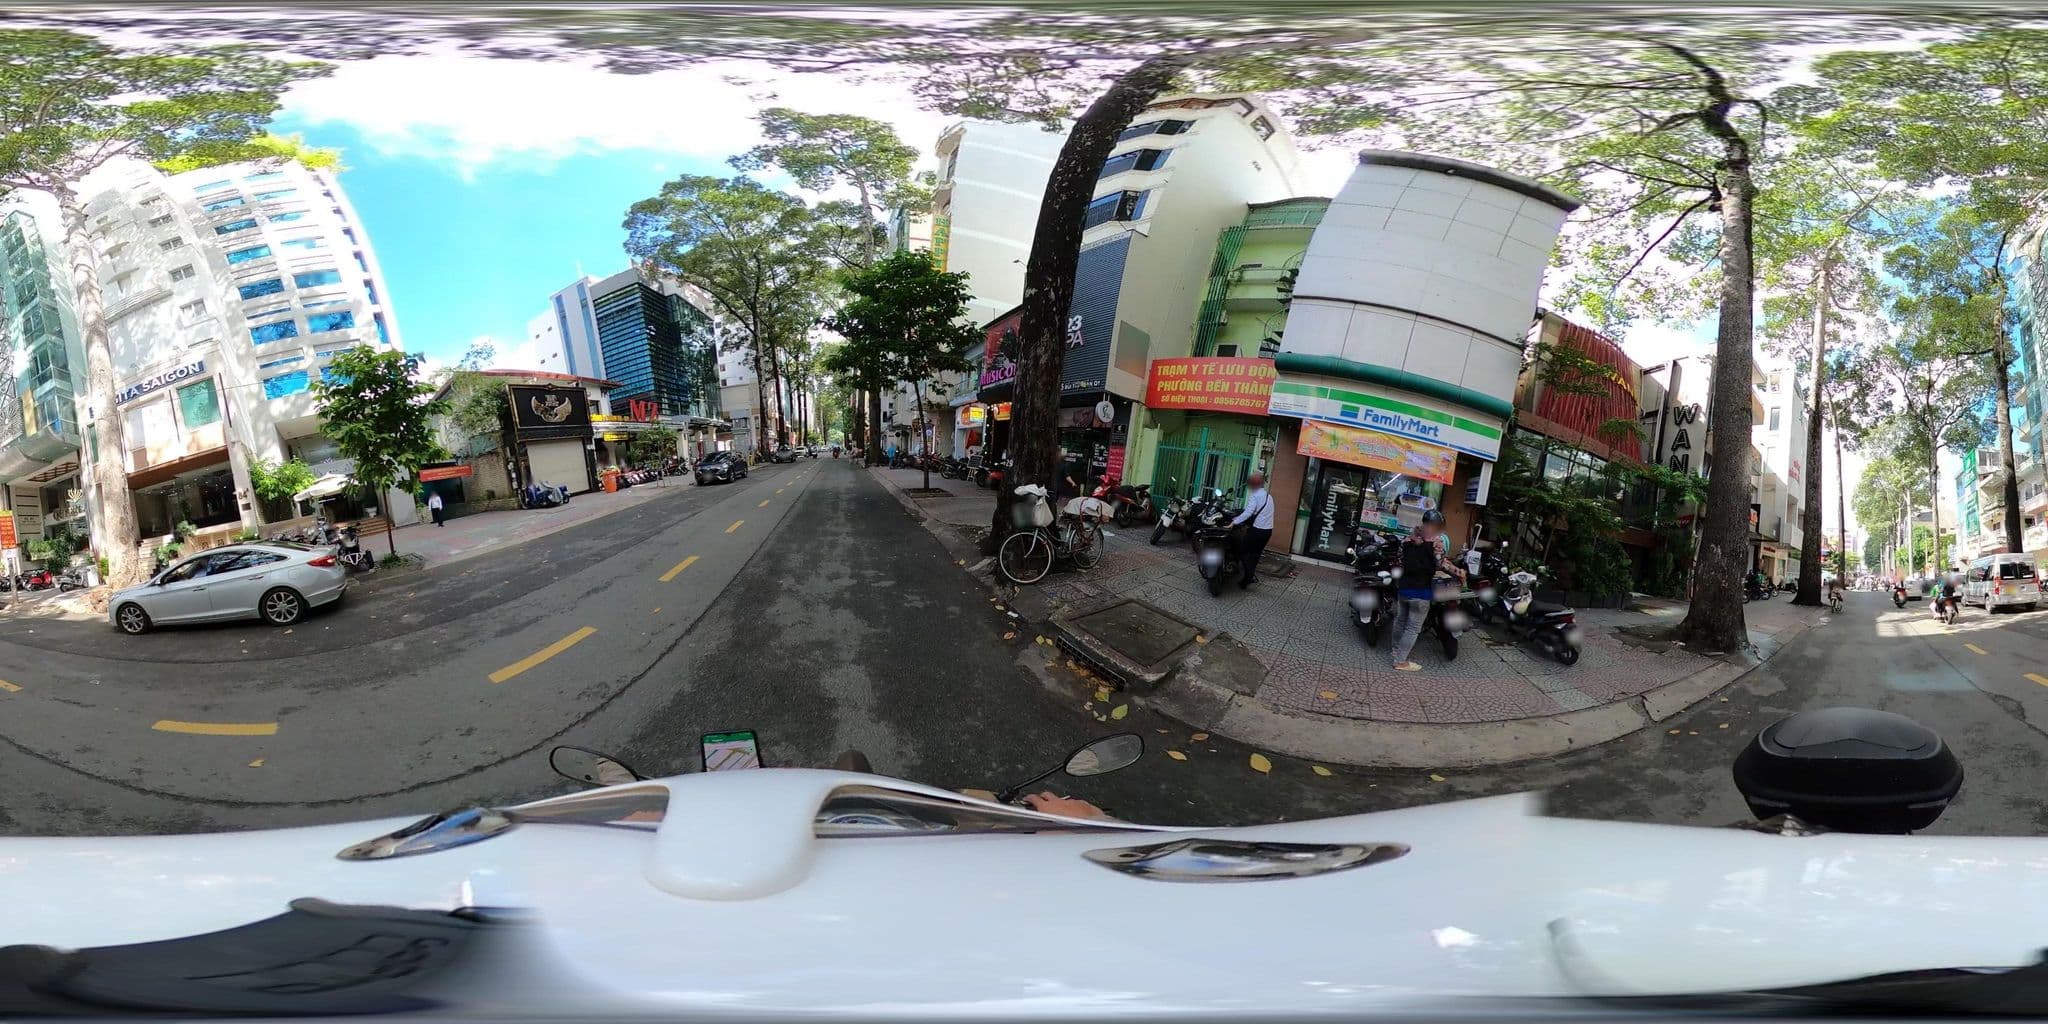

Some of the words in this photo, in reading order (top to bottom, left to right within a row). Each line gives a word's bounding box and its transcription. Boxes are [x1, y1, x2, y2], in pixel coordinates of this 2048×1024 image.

[142, 362, 203, 395] SAIGON
[1191, 364, 1199, 374] Y
[1248, 363, 1278, 379] ĐỘN
[1364, 409, 1440, 437] FamilyMart
